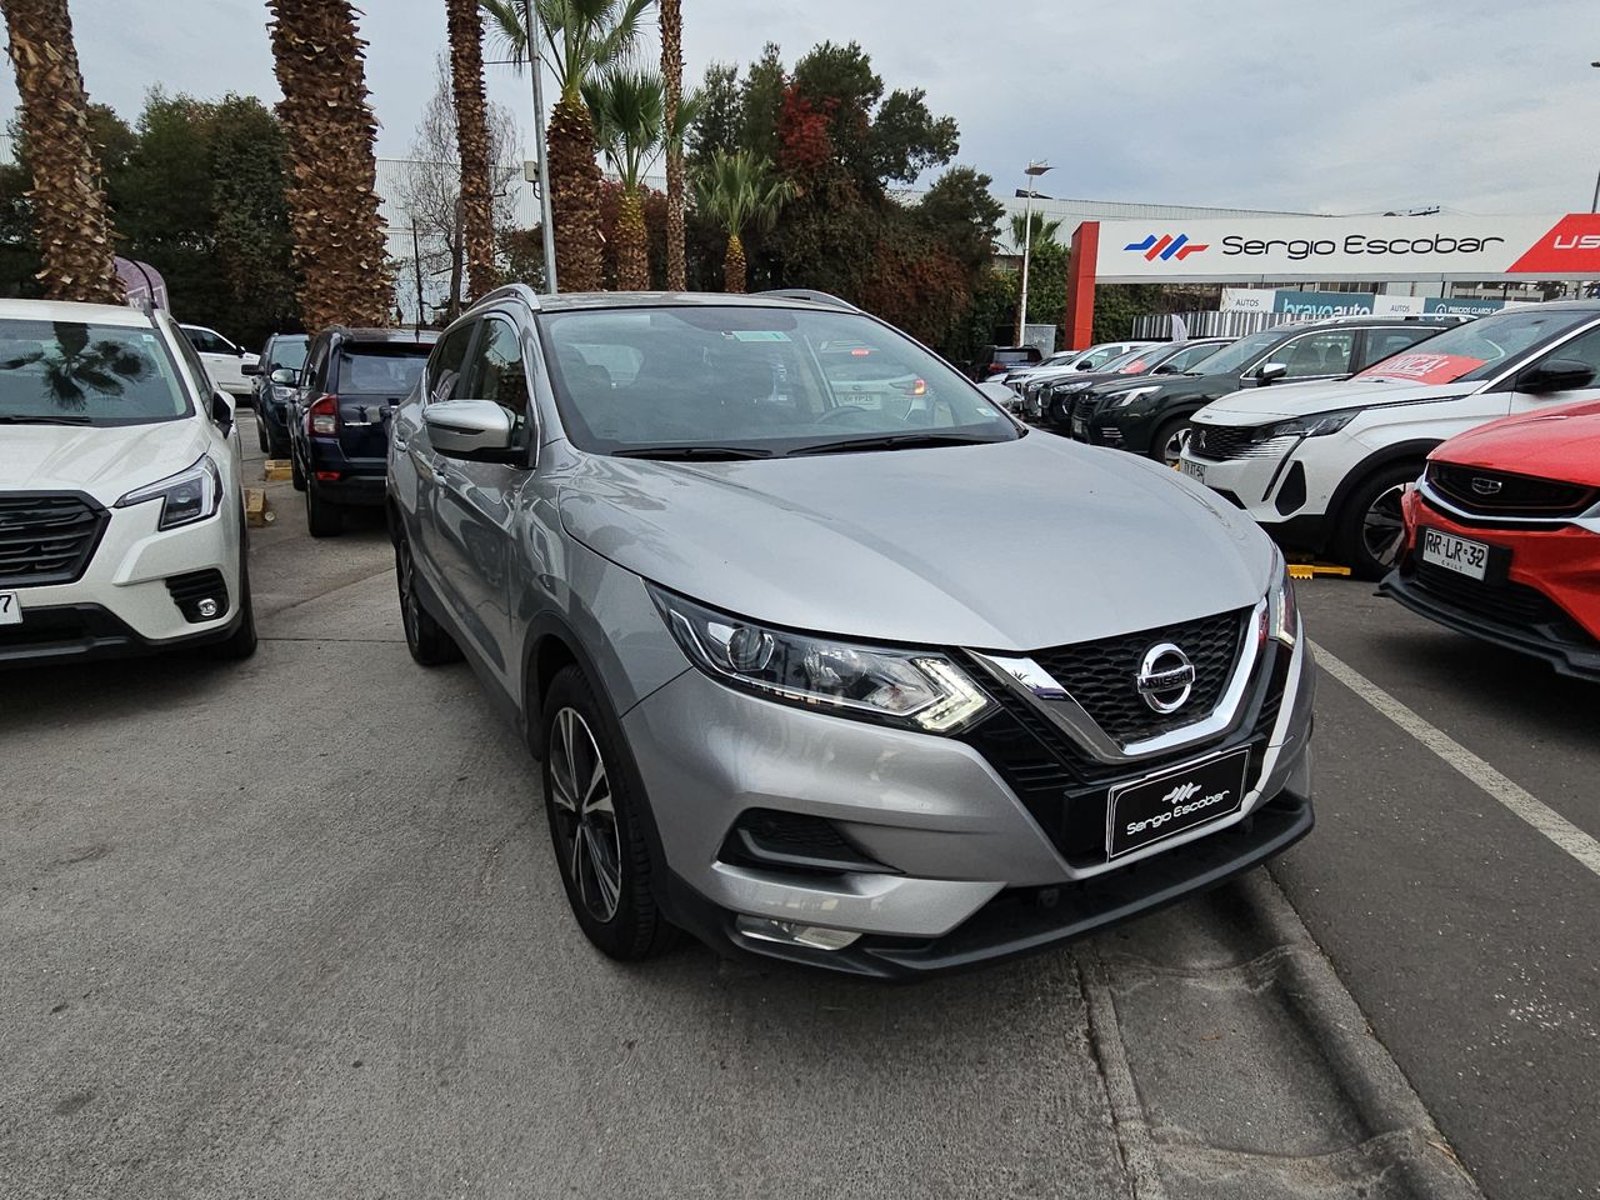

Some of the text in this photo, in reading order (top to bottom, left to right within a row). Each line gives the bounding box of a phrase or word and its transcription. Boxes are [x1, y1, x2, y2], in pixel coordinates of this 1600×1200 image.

[1222, 233, 1505, 260] Sergio Escobar
[1553, 234, 1600, 249] US
[1235, 299, 1260, 307] AUTOS
[1283, 298, 1370, 315] bravoauto
[1390, 304, 1411, 312] AUTOS
[1173, 790, 1230, 818] Escobar
